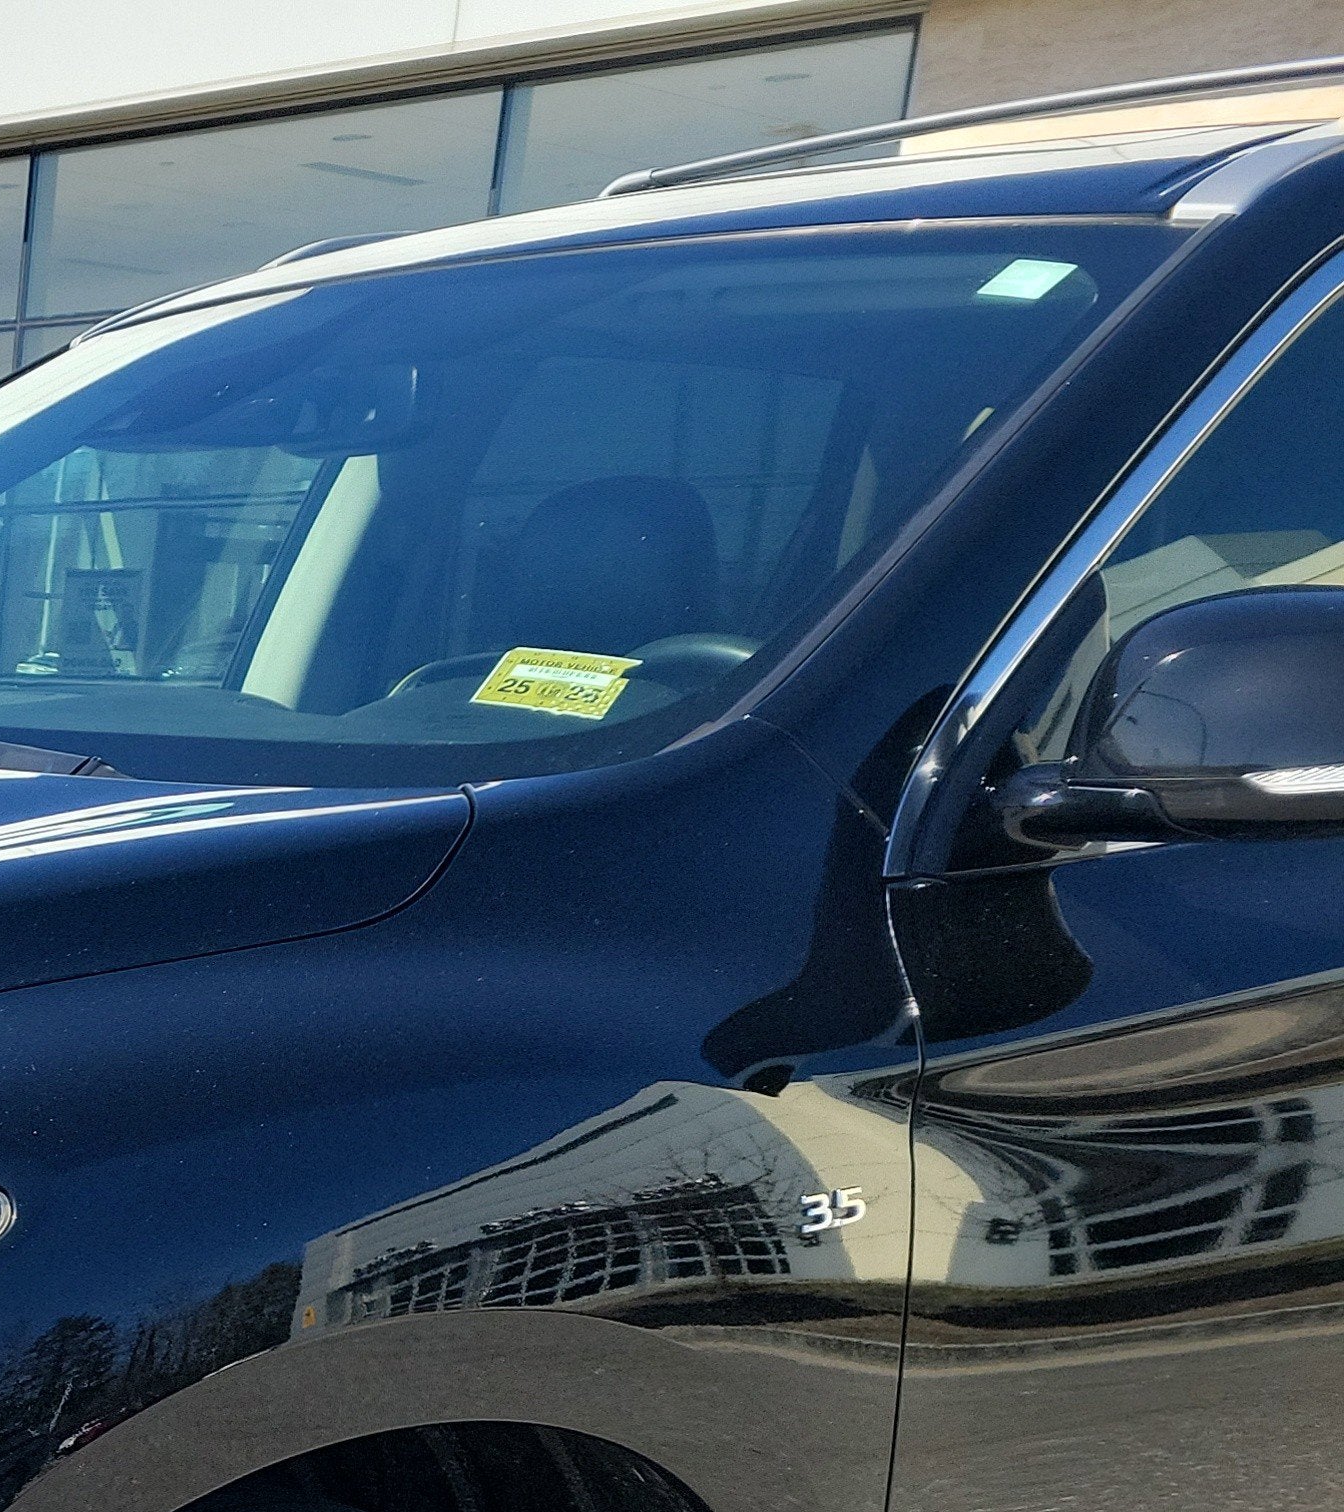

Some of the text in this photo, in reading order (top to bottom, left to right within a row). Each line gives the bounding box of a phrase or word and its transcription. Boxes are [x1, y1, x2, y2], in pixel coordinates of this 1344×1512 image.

[520, 658, 563, 668] MOTOR
[497, 677, 535, 694] 25
[799, 1185, 867, 1234] 35
